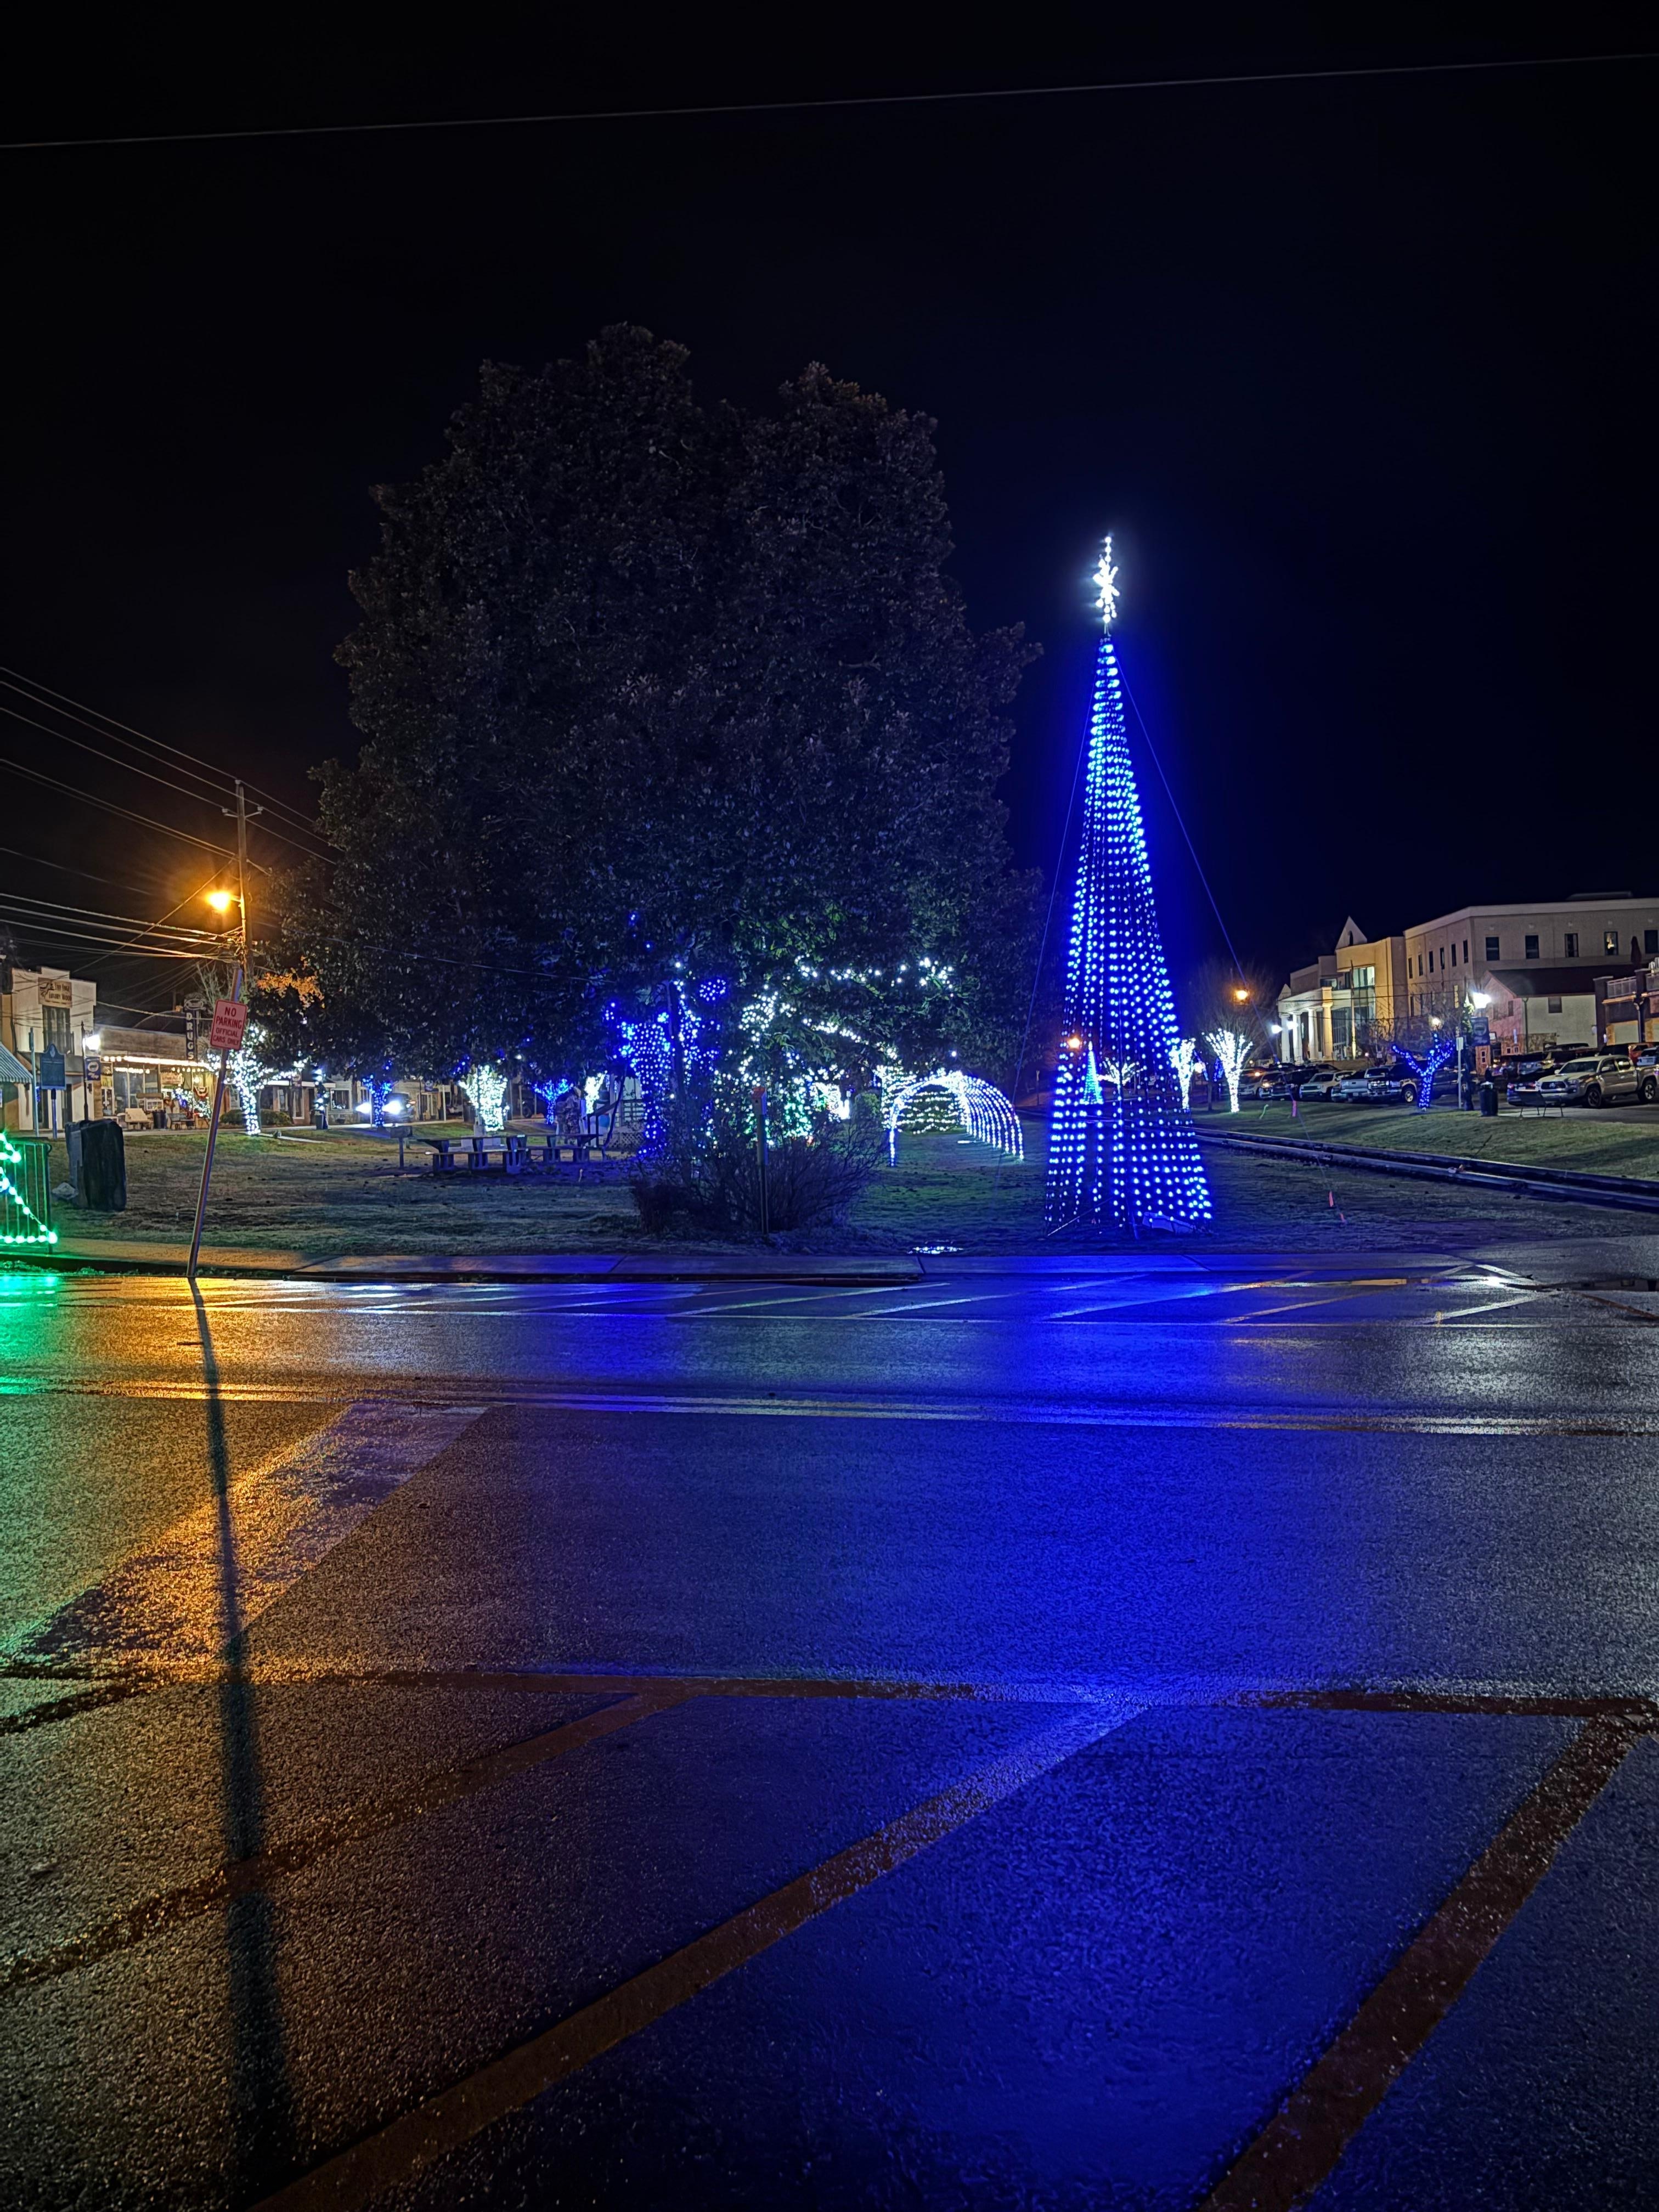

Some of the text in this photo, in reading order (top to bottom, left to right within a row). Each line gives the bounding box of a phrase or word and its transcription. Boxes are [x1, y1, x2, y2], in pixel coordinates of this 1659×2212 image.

[224, 1007, 236, 1017] NO
[216, 1015, 242, 1029] PARKING
[216, 1028, 238, 1037] OFFICIAL
[212, 1035, 225, 1043] CARS
